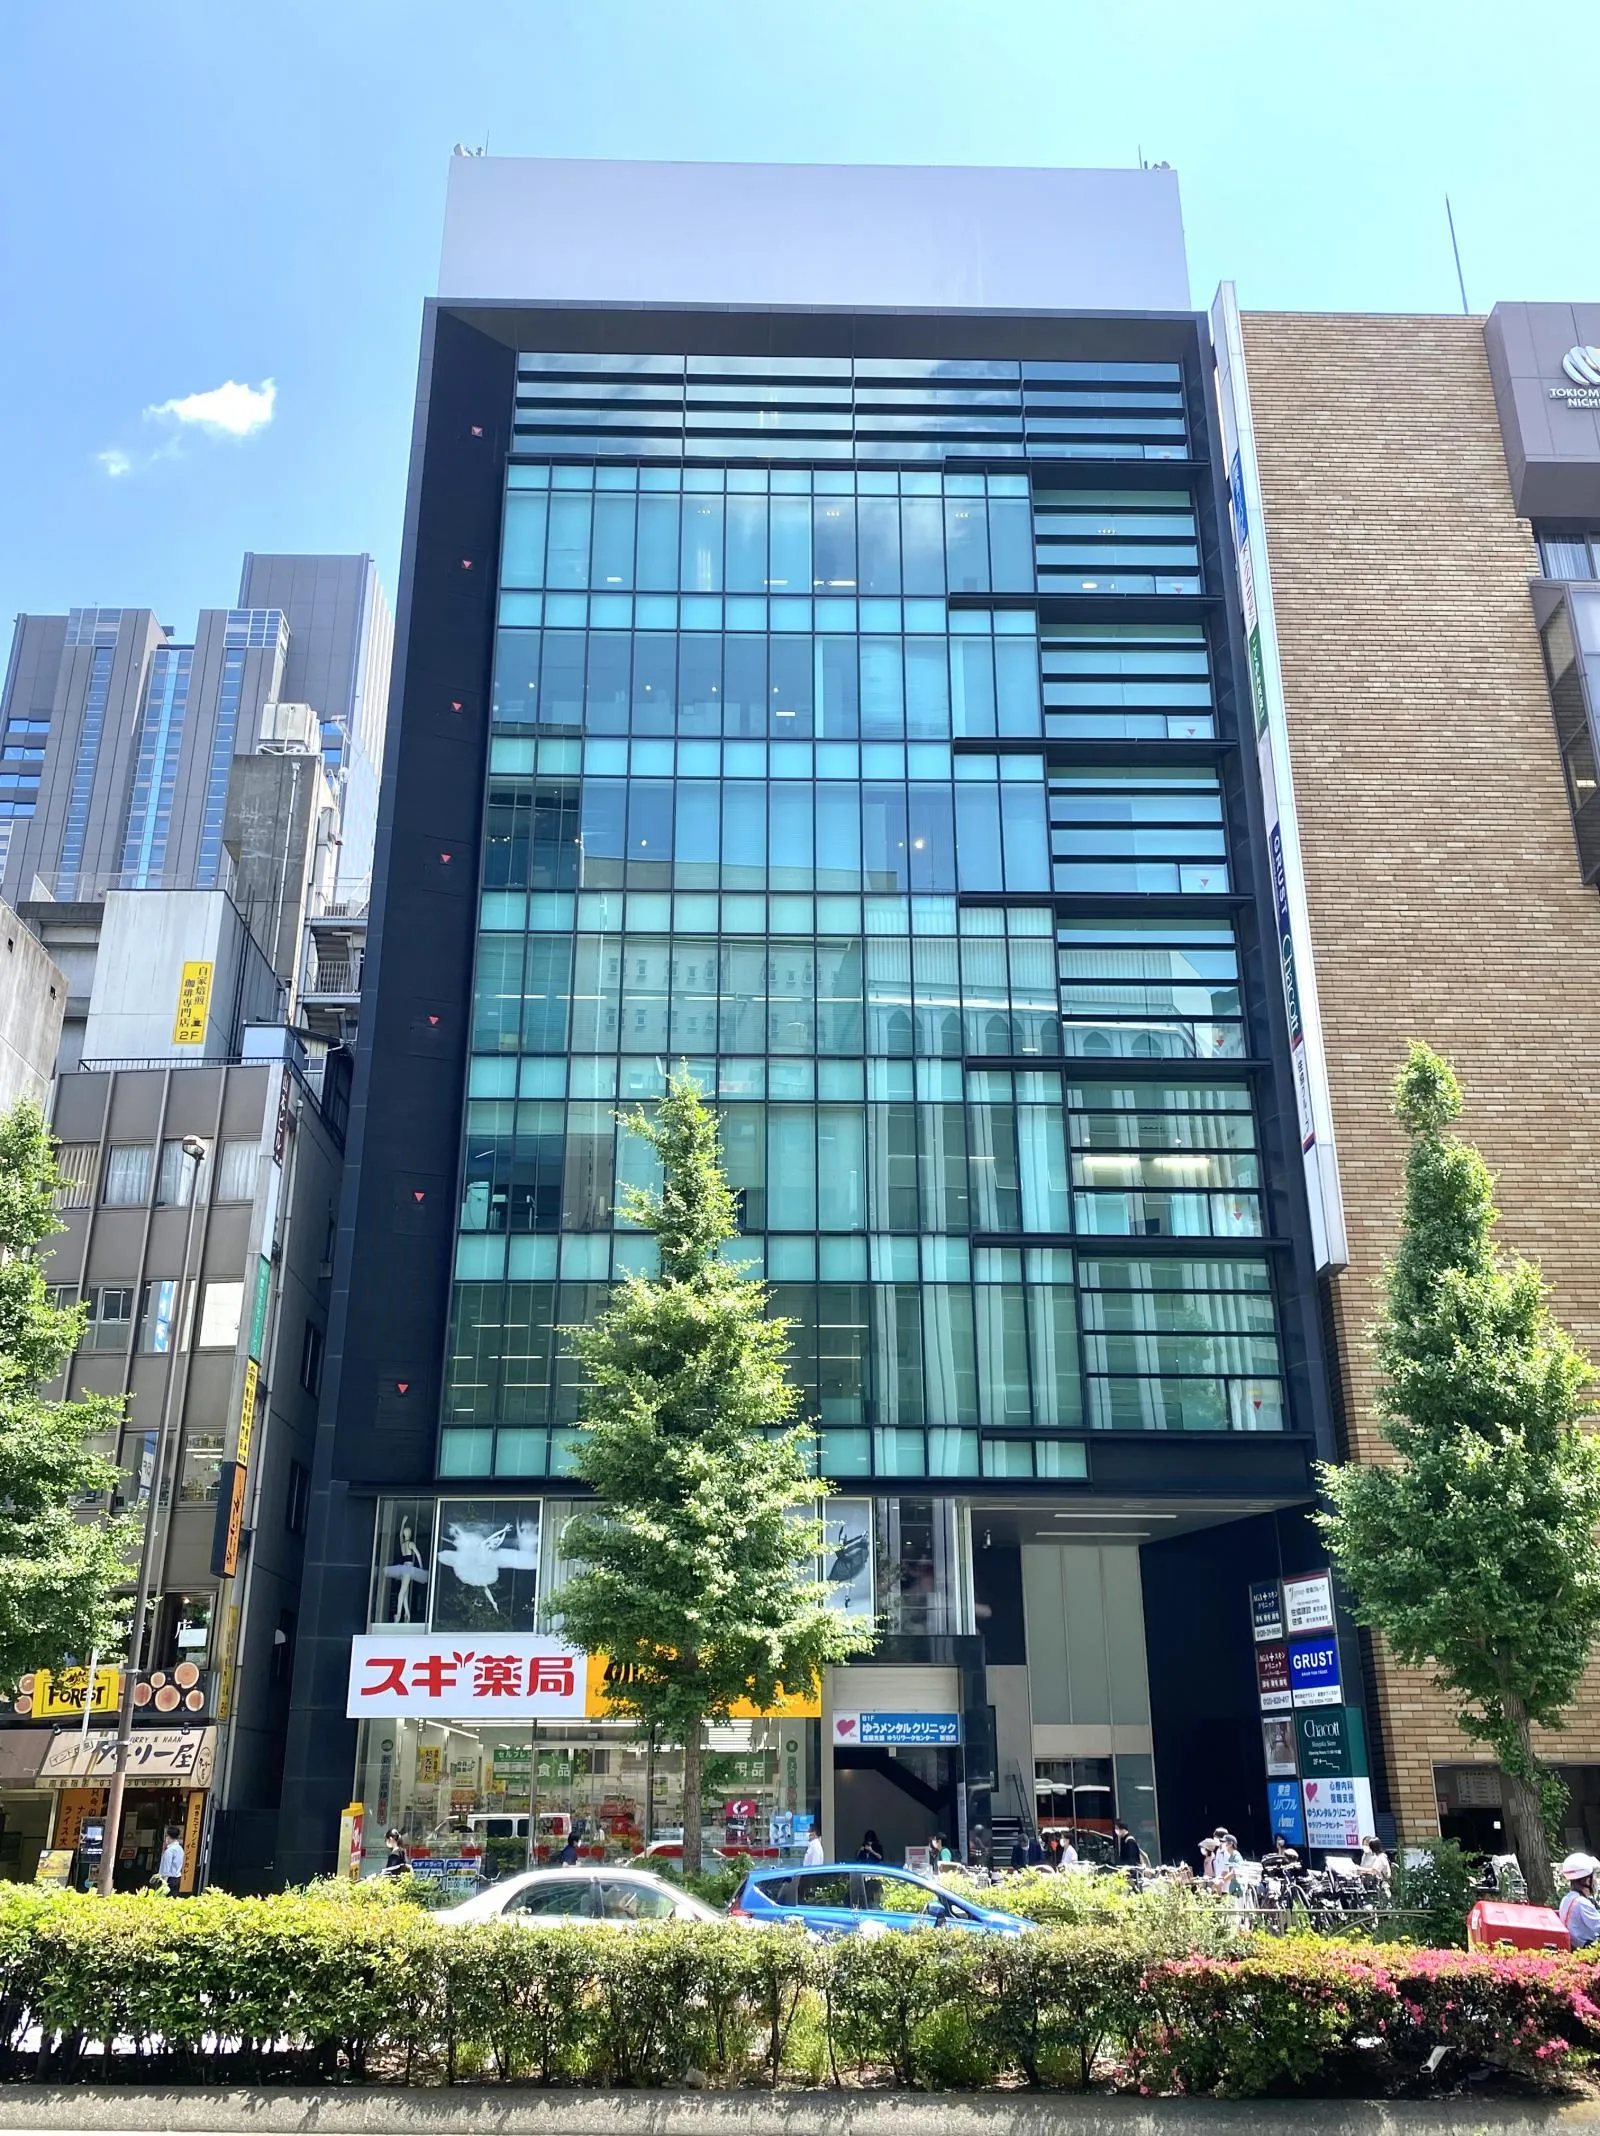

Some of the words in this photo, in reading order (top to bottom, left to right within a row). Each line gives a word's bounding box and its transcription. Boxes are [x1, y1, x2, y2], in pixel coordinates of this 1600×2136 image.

[1549, 388, 1587, 397] TOKIO
[1273, 834, 1288, 915] GRUST
[1282, 934, 1299, 1036] Chacott
[179, 1031, 199, 1040] 2F
[1293, 1651, 1333, 1669] GRUST
[360, 1651, 574, 1697] スギ薬局
[862, 1722, 956, 1734] ゆうメンタルクリニック
[1304, 1720, 1340, 1738] Chacott
[129, 1736, 149, 1744] URRY
[537, 1763, 571, 1777] 食品
[1307, 1808, 1356, 1818] ゆうメンタルクリニック
